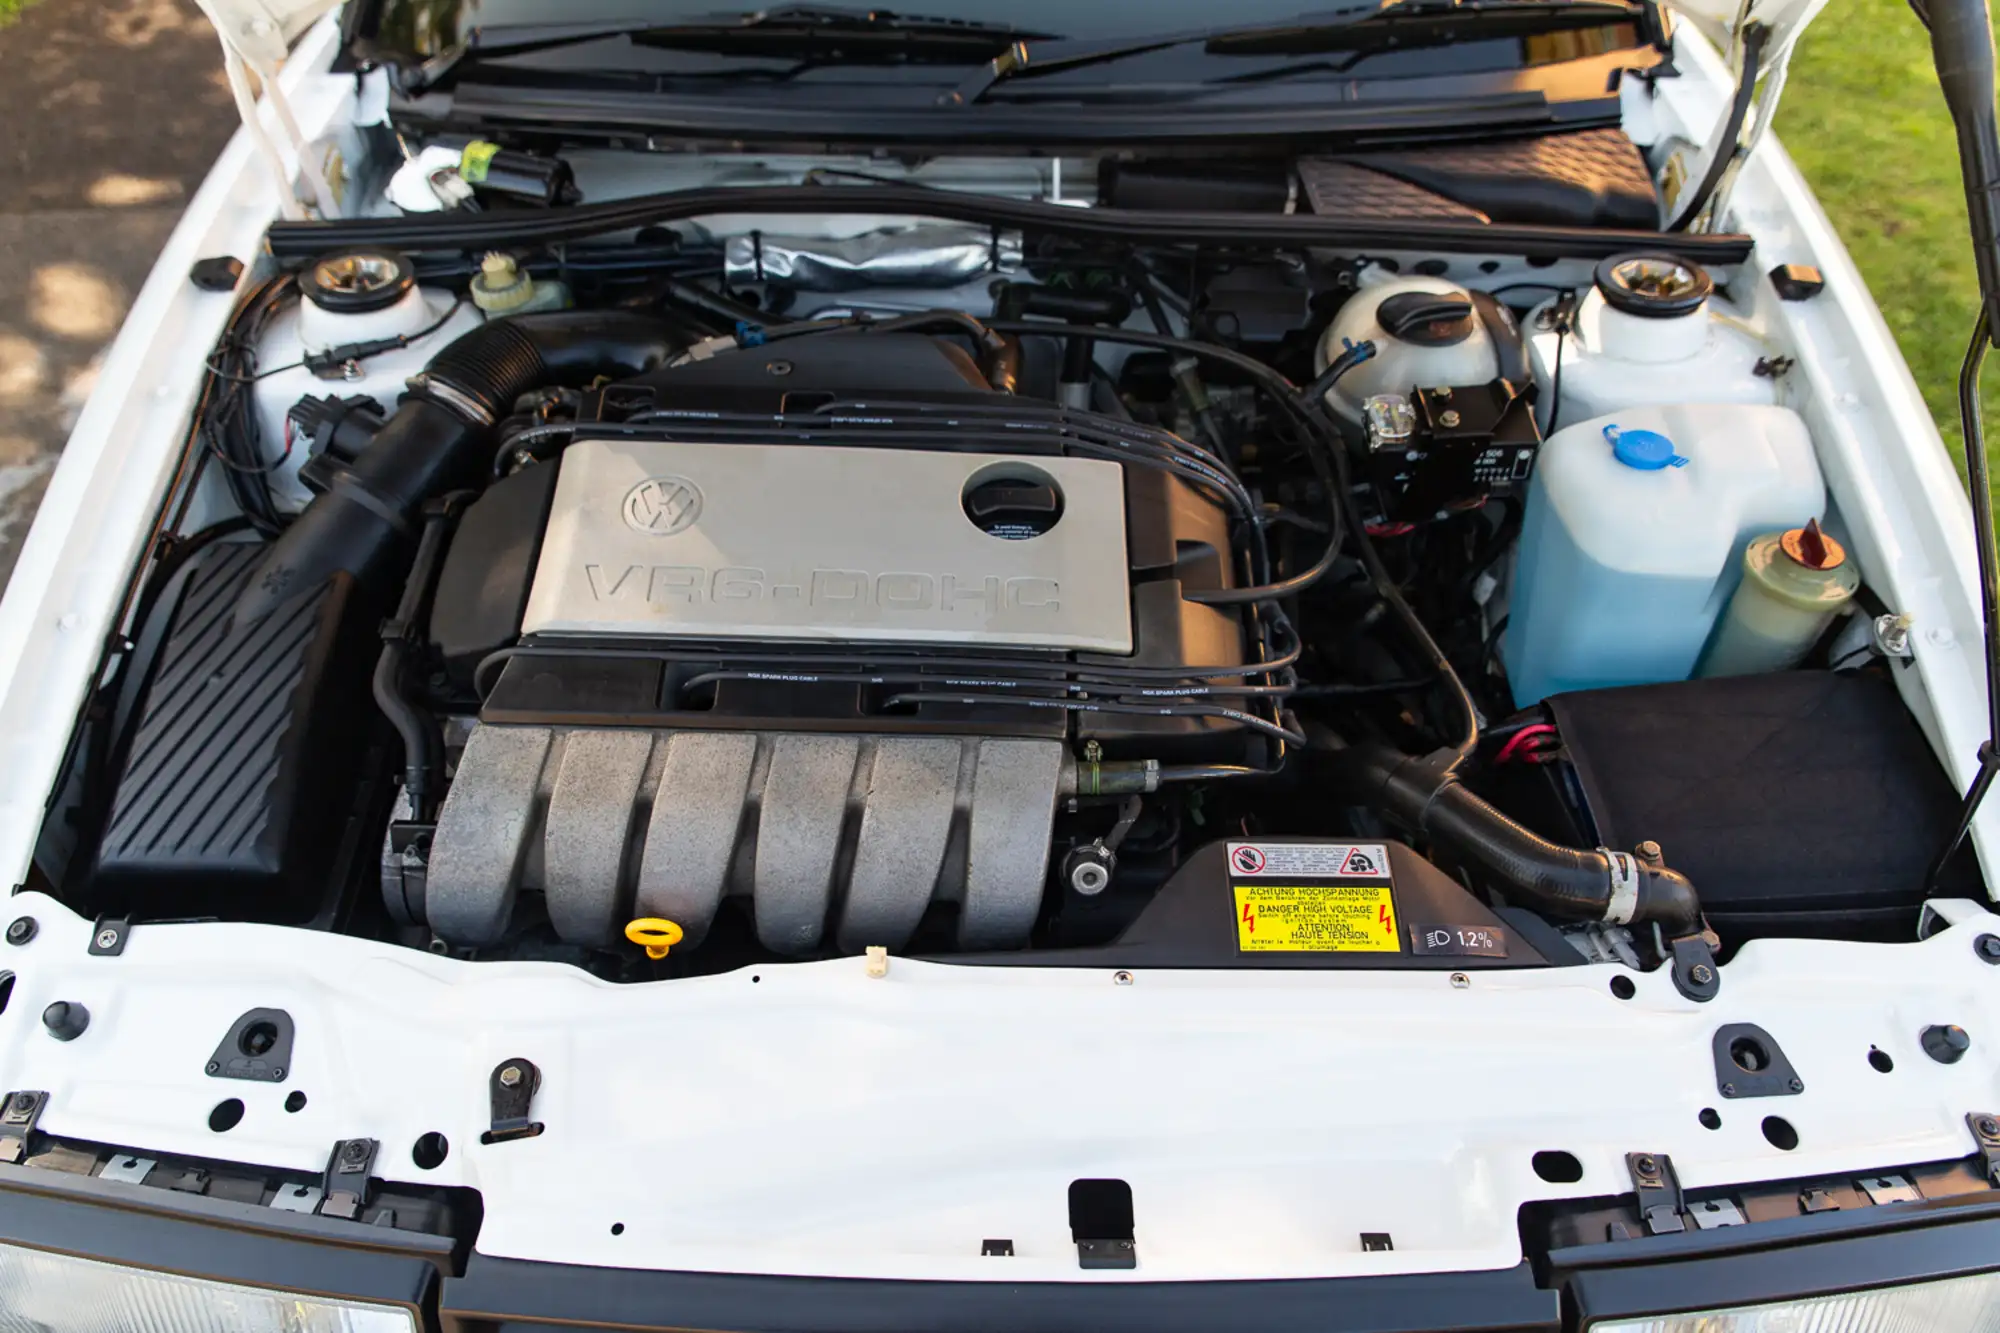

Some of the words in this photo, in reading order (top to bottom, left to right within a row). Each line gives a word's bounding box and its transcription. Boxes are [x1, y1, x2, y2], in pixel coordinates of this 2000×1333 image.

[585, 564, 1060, 613] VR6-DOHC
[1250, 888, 1295, 896] ACHTUNG
[1299, 888, 1380, 897] HOCHSPANNUNG
[1258, 905, 1300, 913] DANGER
[1304, 905, 1326, 913] HIGH
[1330, 905, 1374, 913] VOLTAGE
[1291, 931, 1324, 939] HAUTE
[1328, 931, 1369, 939] TENSION
[1457, 930, 1492, 948] 1.2%
